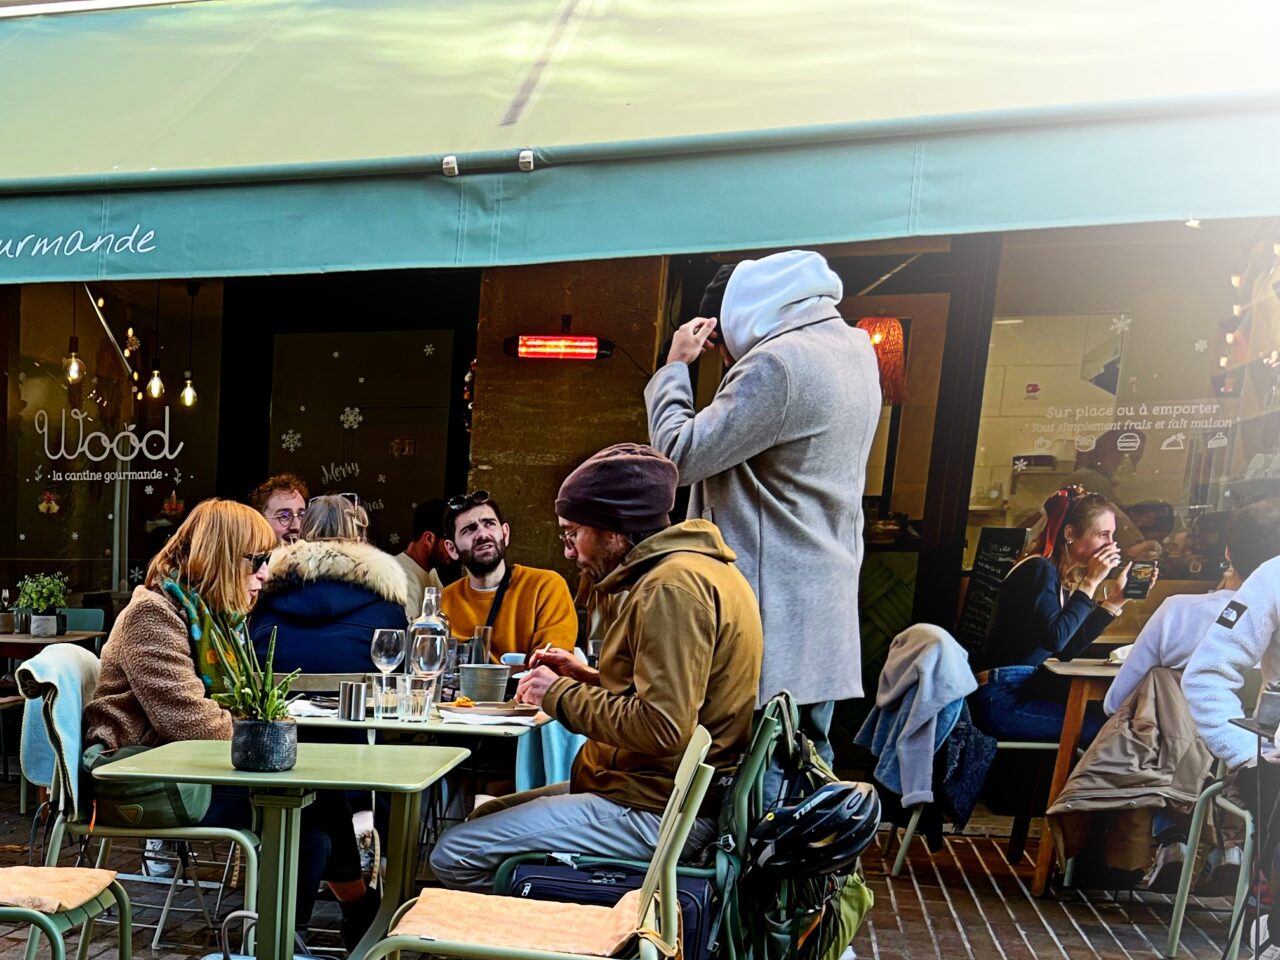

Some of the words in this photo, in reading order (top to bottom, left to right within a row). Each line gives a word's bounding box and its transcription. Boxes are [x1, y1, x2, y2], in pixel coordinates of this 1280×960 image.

[1046, 407, 1072, 418] Sur
[1075, 405, 1113, 420] place
[1117, 408, 1135, 416] ou
[1139, 403, 1148, 416] à
[1152, 403, 1220, 418] emporter
[35, 405, 184, 462] Wood
[52, 470, 63, 481] la
[65, 470, 102, 481] cantine
[104, 469, 162, 483] gourmande
[320, 462, 360, 485] Merry
